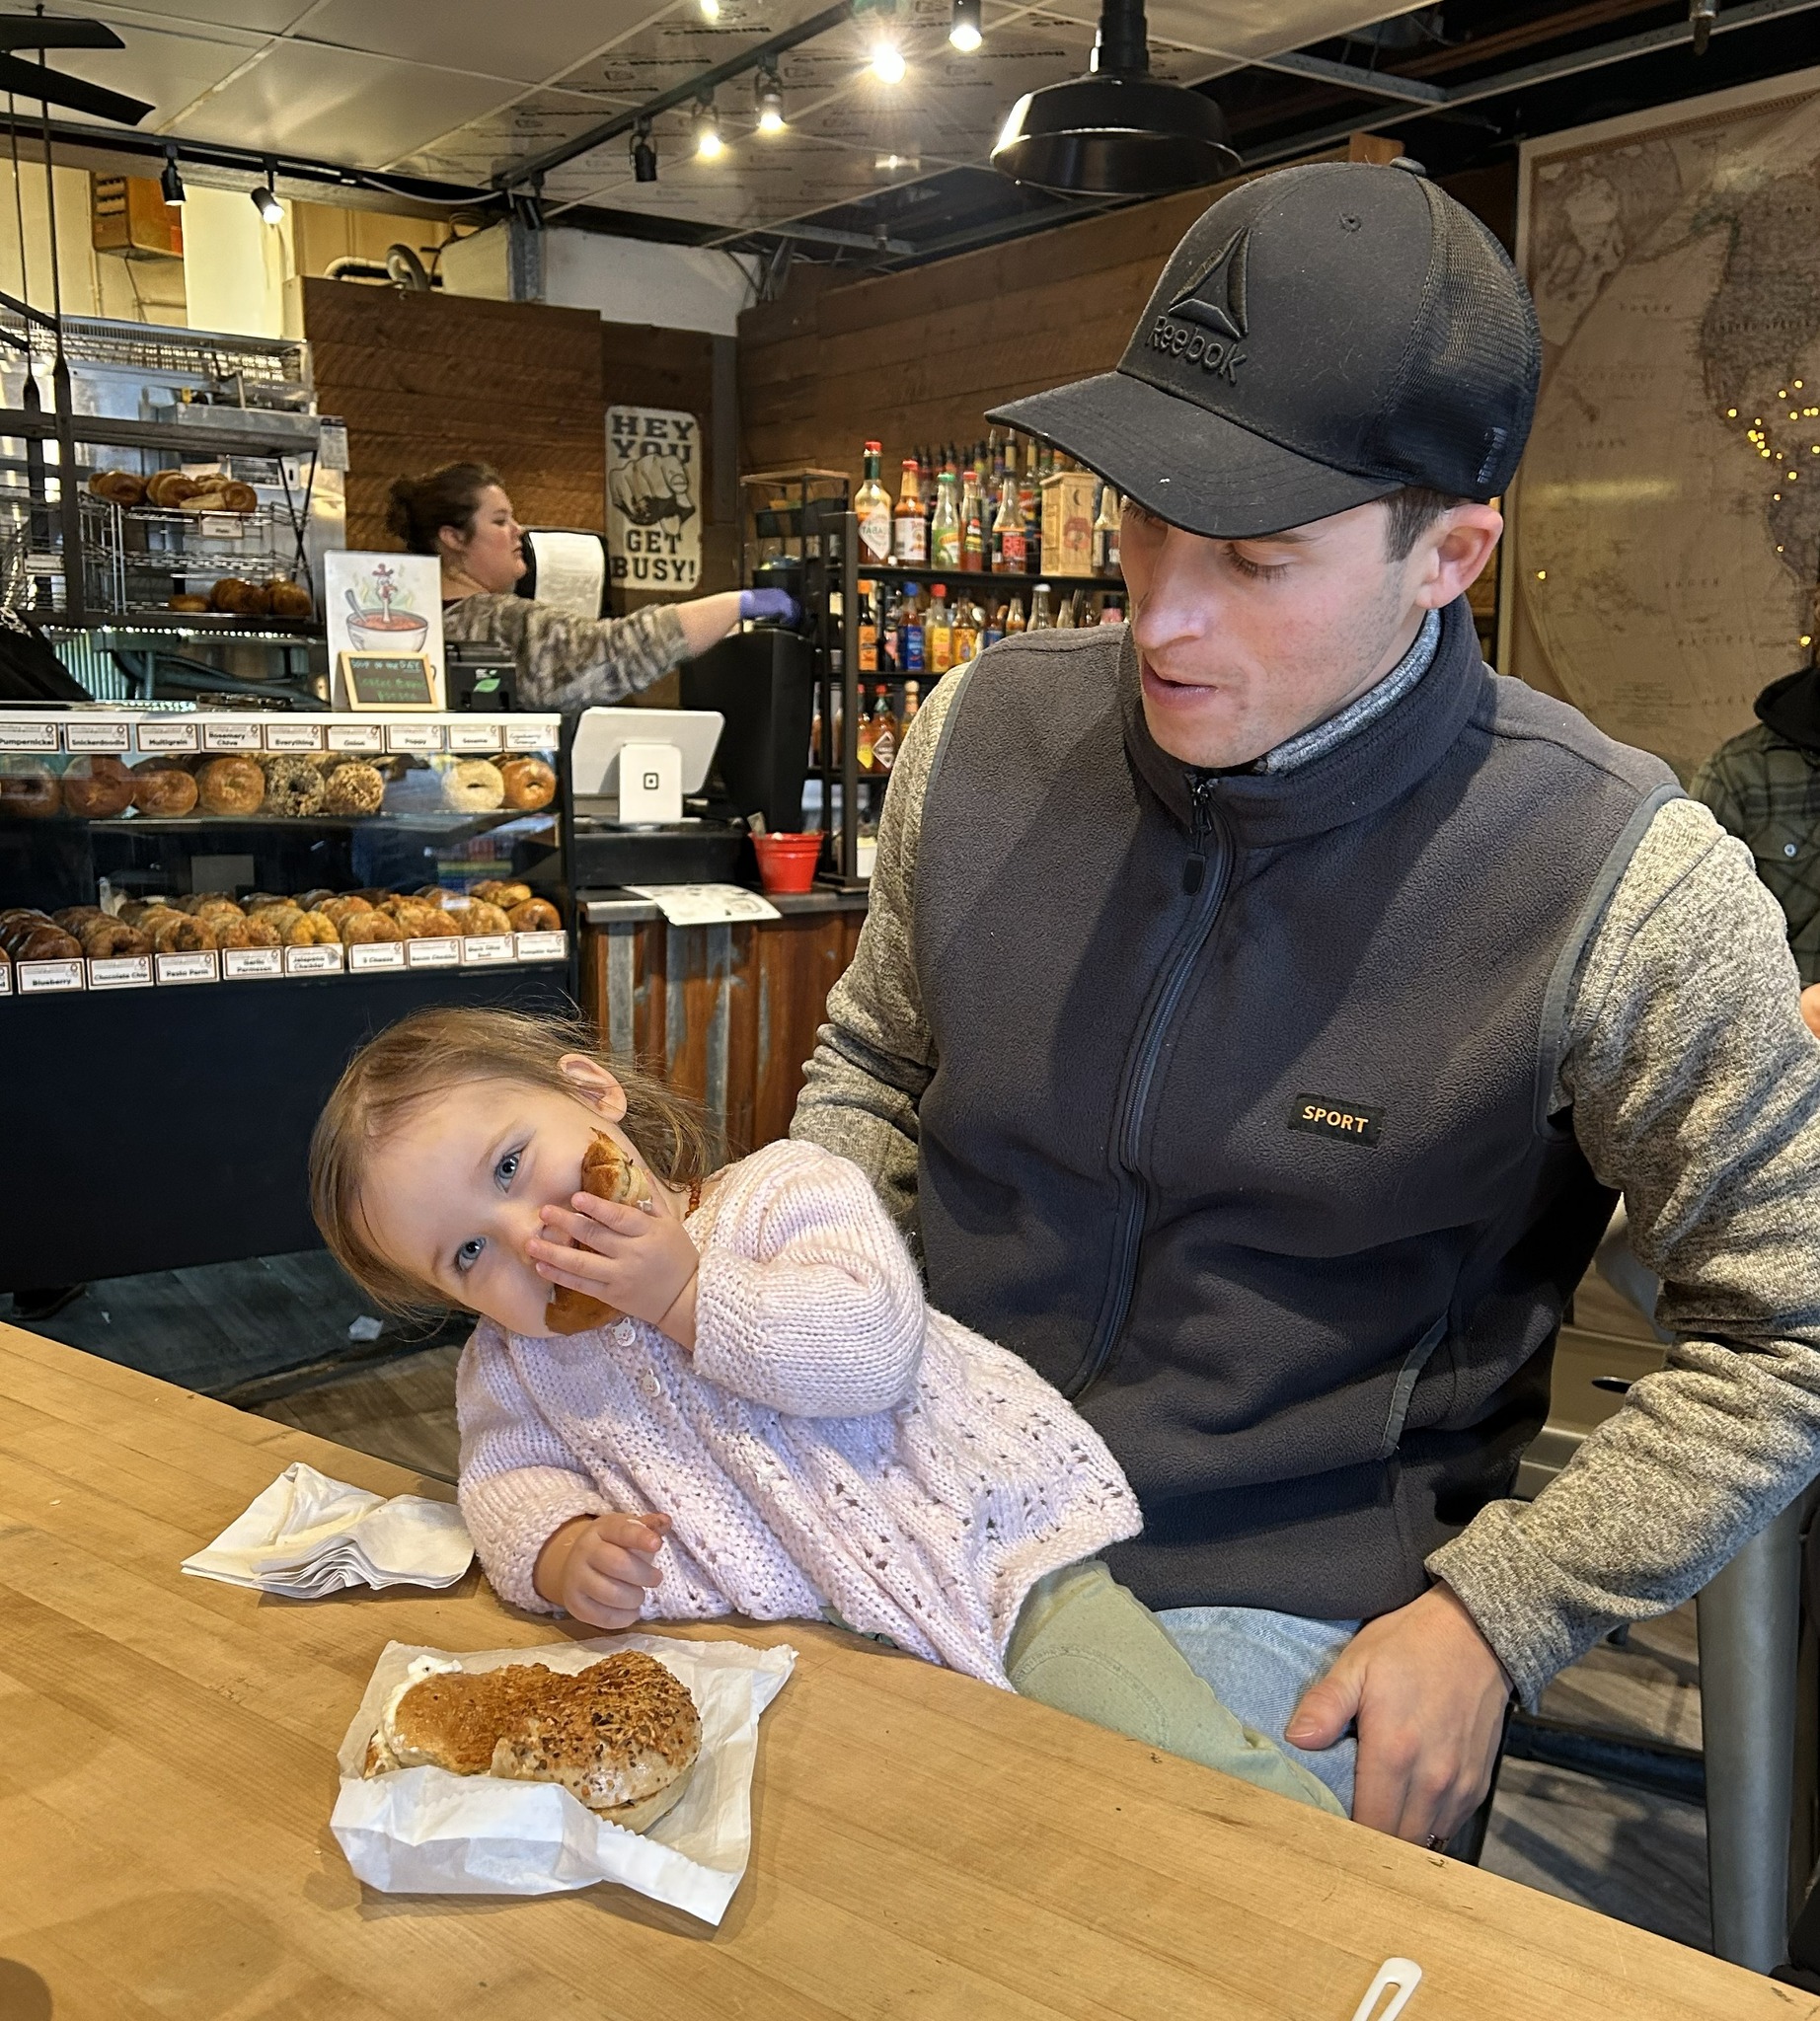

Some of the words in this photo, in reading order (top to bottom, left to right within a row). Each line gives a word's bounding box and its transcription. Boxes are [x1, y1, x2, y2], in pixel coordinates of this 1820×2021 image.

[1144, 315, 1248, 384] Reebok
[611, 414, 694, 440] HEY
[611, 437, 692, 464] YOU
[626, 529, 682, 555] GET
[611, 556, 695, 582] BUSY!
[1302, 1105, 1370, 1134] SPORT
